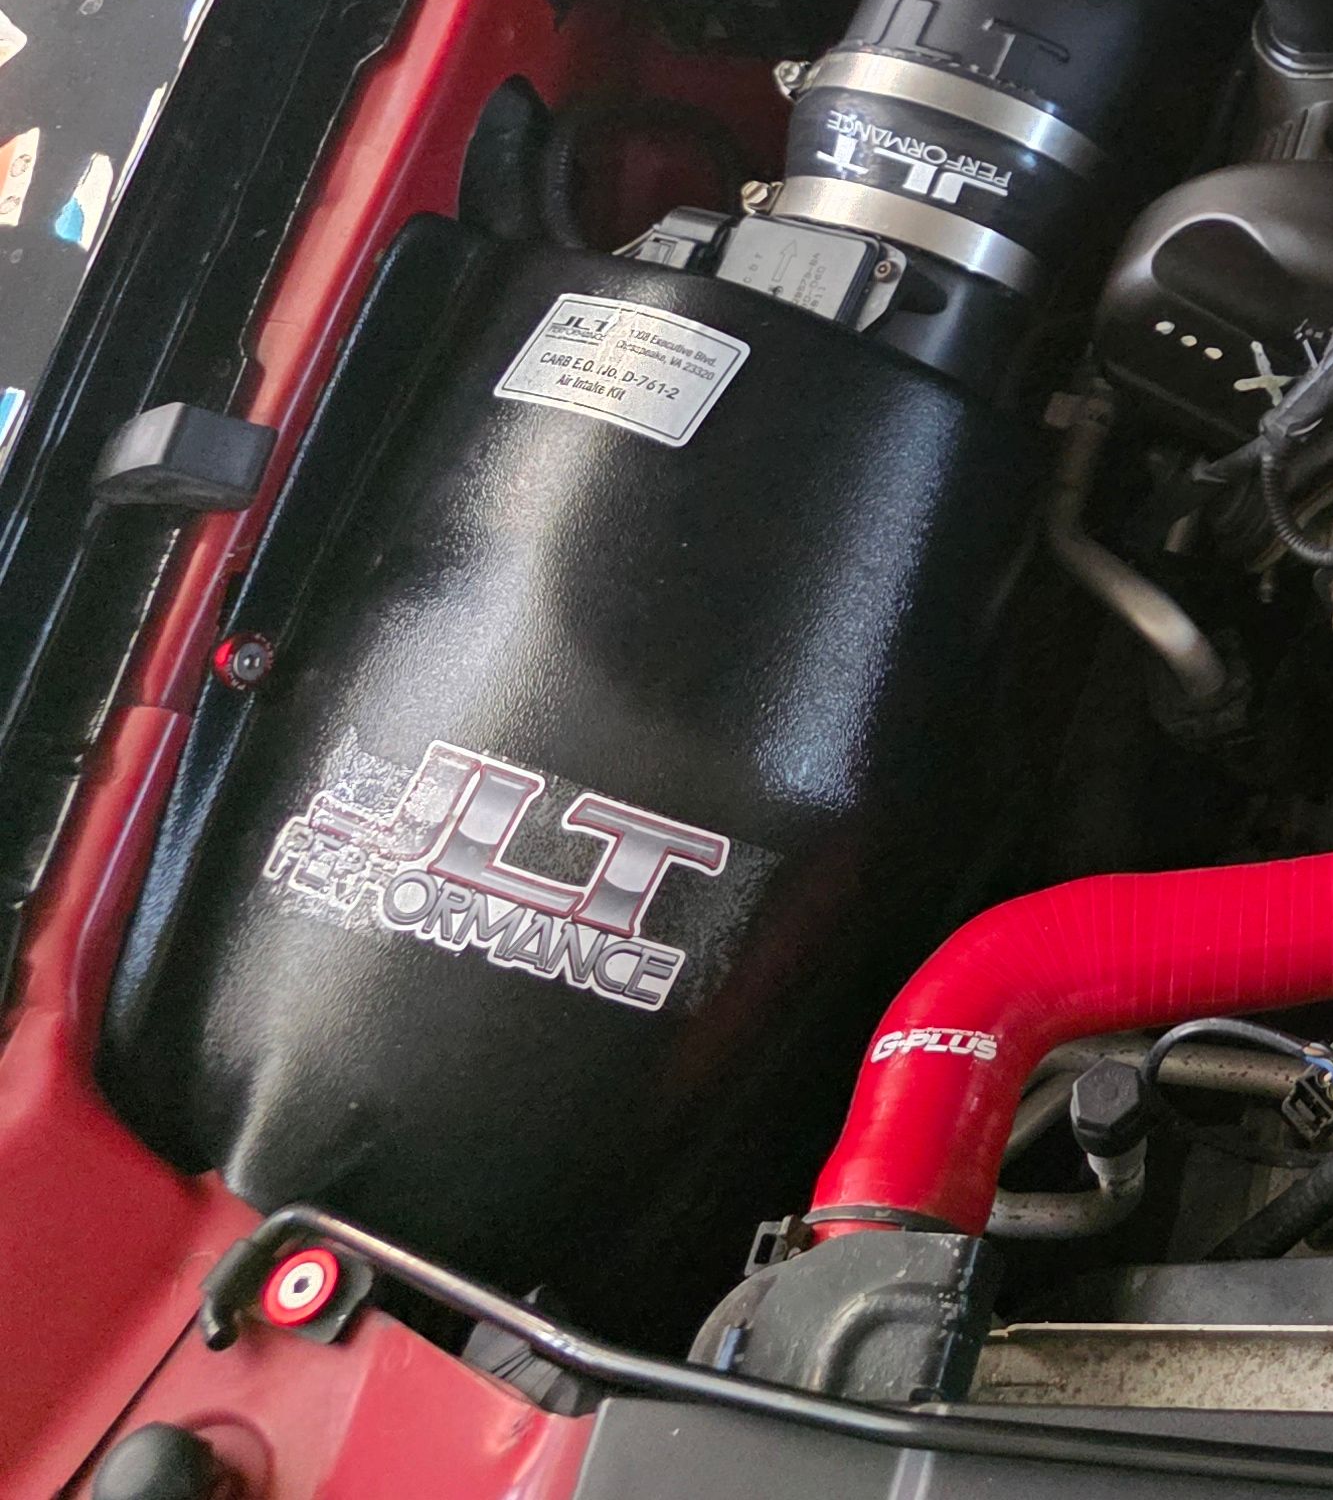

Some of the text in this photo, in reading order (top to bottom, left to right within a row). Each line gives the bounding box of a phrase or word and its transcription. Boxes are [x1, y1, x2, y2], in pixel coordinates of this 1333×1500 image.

[817, 132, 1008, 204] JLT
[826, 109, 1012, 190] PERFORMANCE
[553, 314, 610, 334] JLT
[652, 333, 695, 358] Executive
[694, 349, 717, 367] Blvd.
[668, 356, 683, 369] VA
[682, 360, 715, 381] 23320
[539, 351, 571, 368] CARB
[622, 369, 681, 401] D-761-2
[556, 373, 627, 401] Air Intake Kit
[309, 740, 730, 938] JLT
[264, 818, 685, 1012] PERFORMANCE
[871, 1030, 998, 1063] G-PLUS
